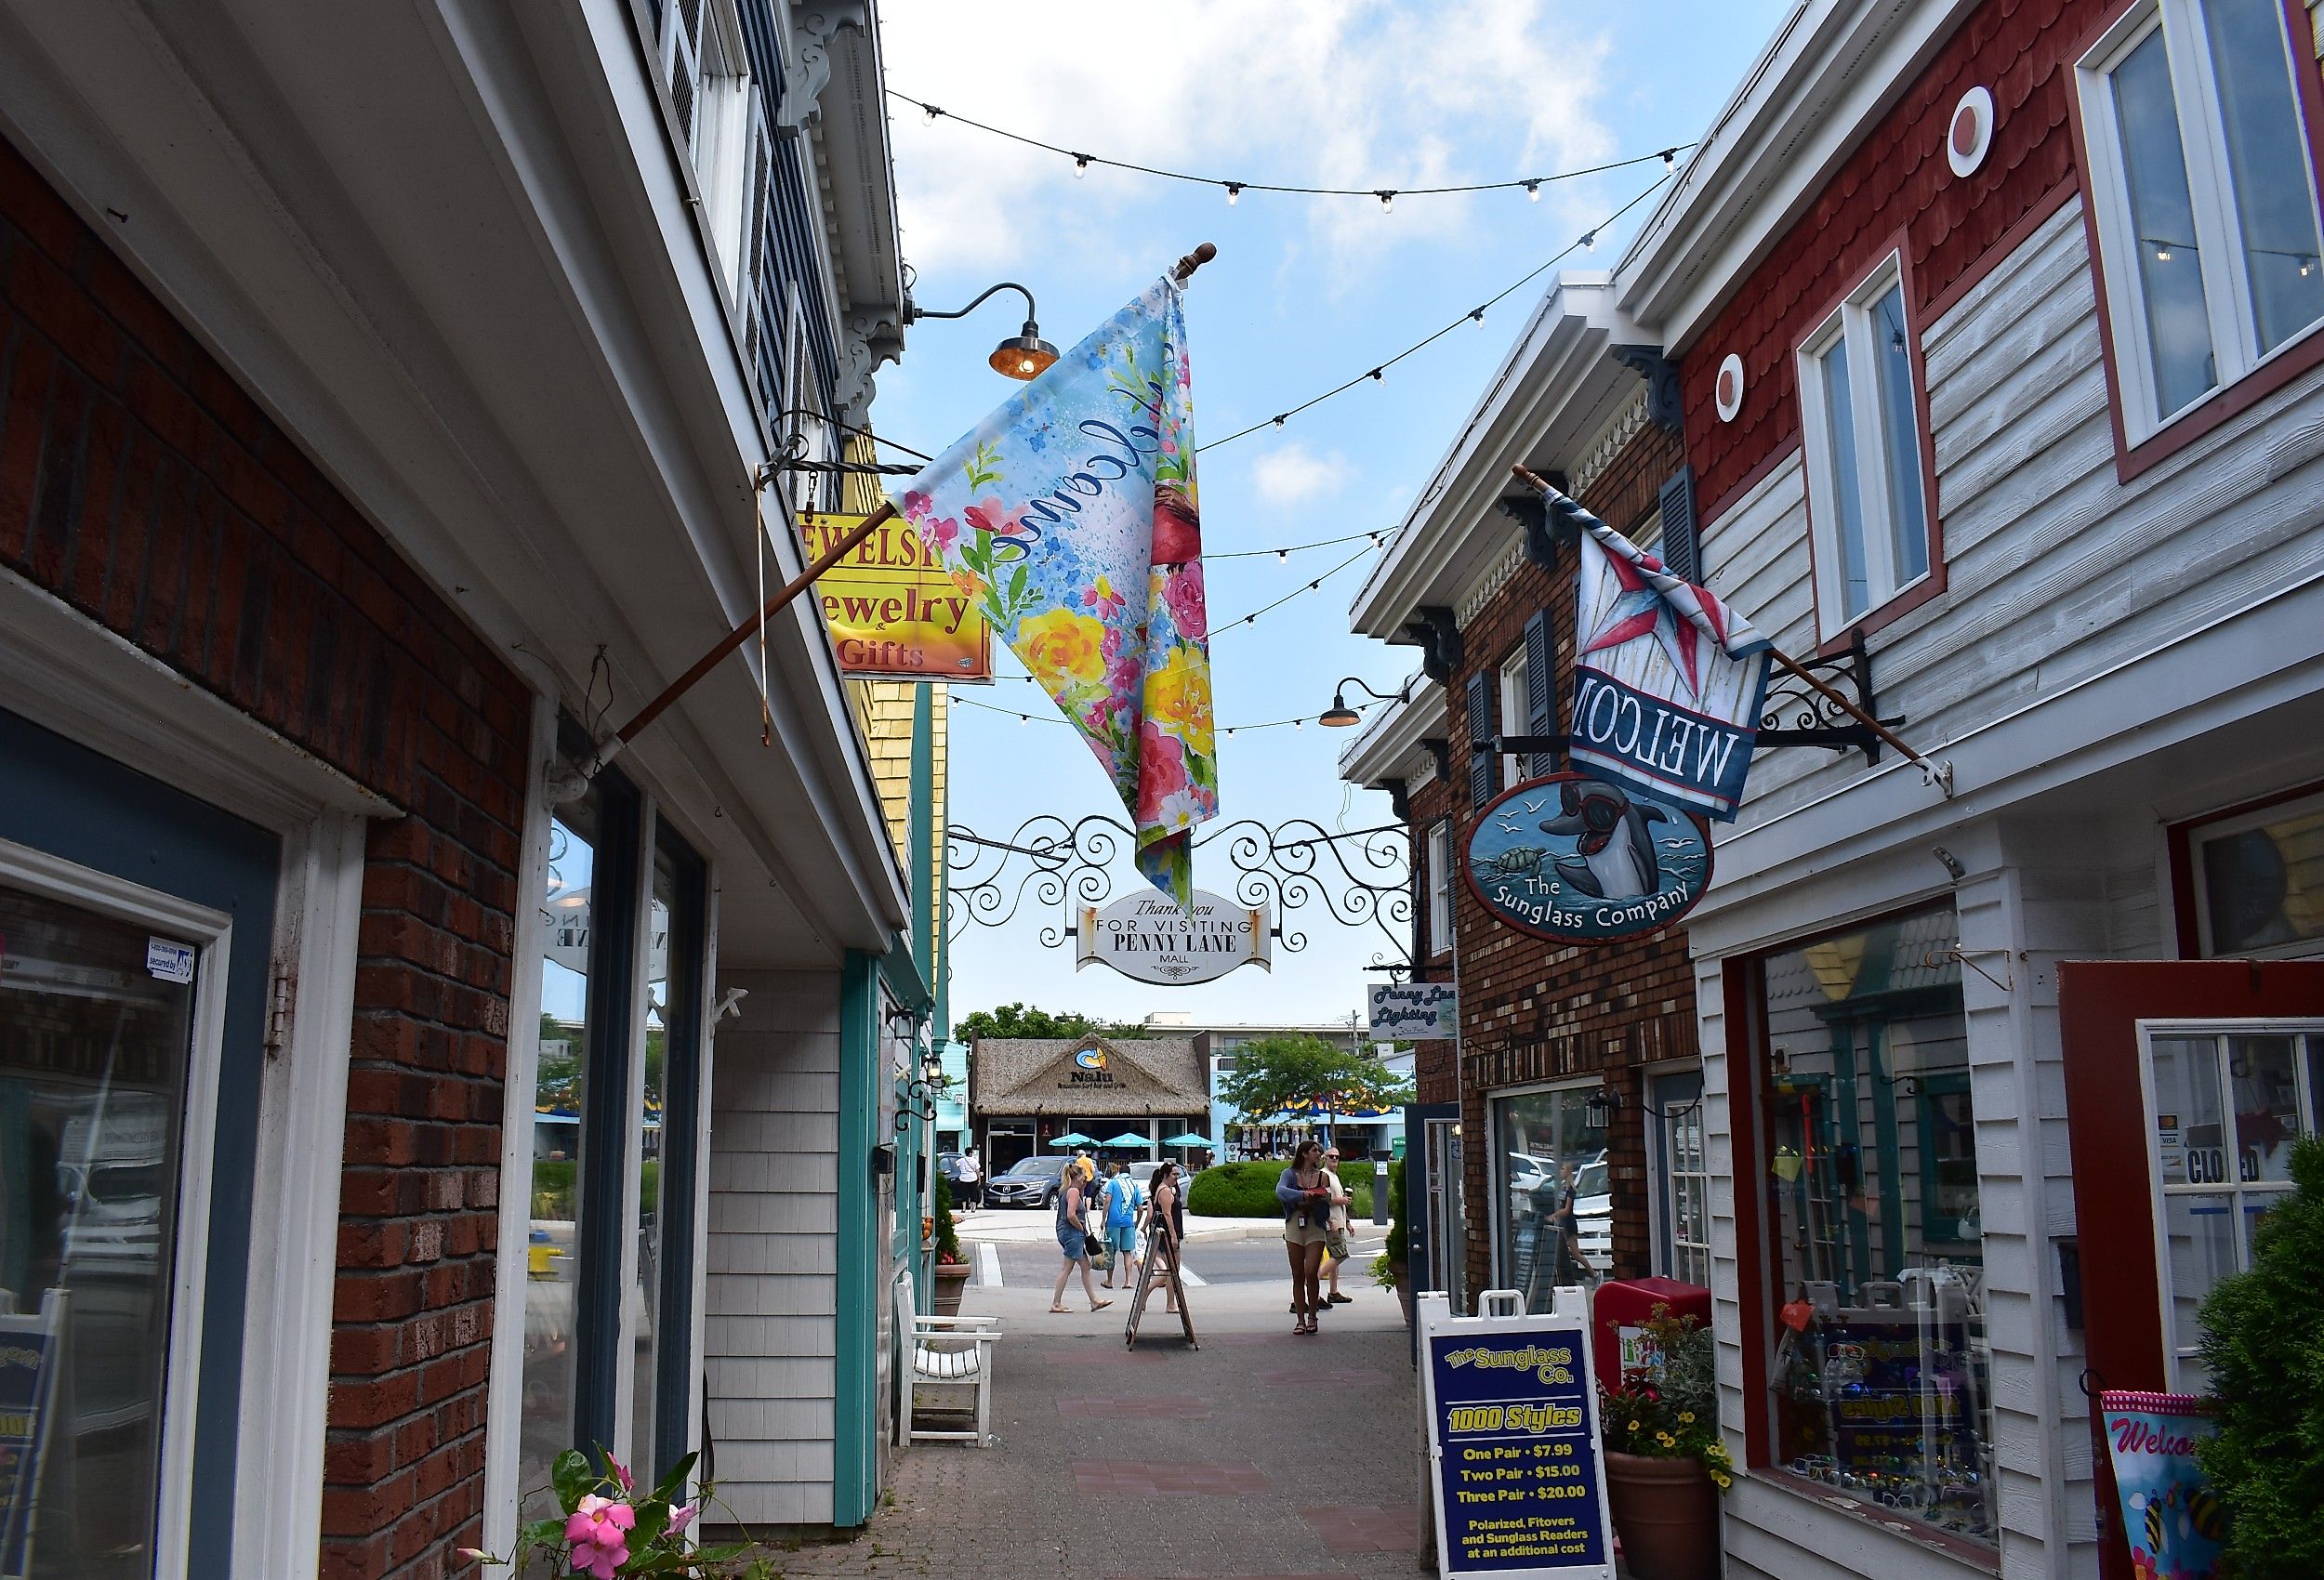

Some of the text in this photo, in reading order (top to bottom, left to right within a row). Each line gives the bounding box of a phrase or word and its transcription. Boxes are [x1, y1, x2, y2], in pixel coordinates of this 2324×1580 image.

[822, 588, 969, 634] ewelry
[876, 623, 886, 631] &
[837, 639, 923, 667] Gifts
[1525, 876, 1561, 896] The
[1134, 900, 1181, 915] Thank
[1492, 881, 1690, 928] Sunglass Company
[1096, 920, 1252, 933] FOR VISITING
[1114, 933, 1236, 953] PENNY LANE
[150, 957, 169, 968] secured
[170, 959, 177, 971] by
[1159, 955, 1189, 964] MALL
[1373, 985, 1456, 1006] Penny Lan
[1371, 1006, 1438, 1028] Lighting
[1070, 1071, 1114, 1083] Nalu
[2187, 1149, 2260, 1184] CLOED
[1445, 1345, 1572, 1371] The Sunglass
[1538, 1365, 1574, 1385] Co.
[1447, 1403, 1582, 1433] 1000 Styles
[1463, 1443, 1573, 1460] One Pair $7.99
[1460, 1465, 1580, 1482] Two Pair $15.00
[1457, 1485, 1586, 1503] Three Pair $20.00
[1469, 1516, 1575, 1532] Polarized, Fitovers
[1461, 1529, 1588, 1547] and Sunglass Readers
[1467, 1543, 1586, 1559] at an additional cost
